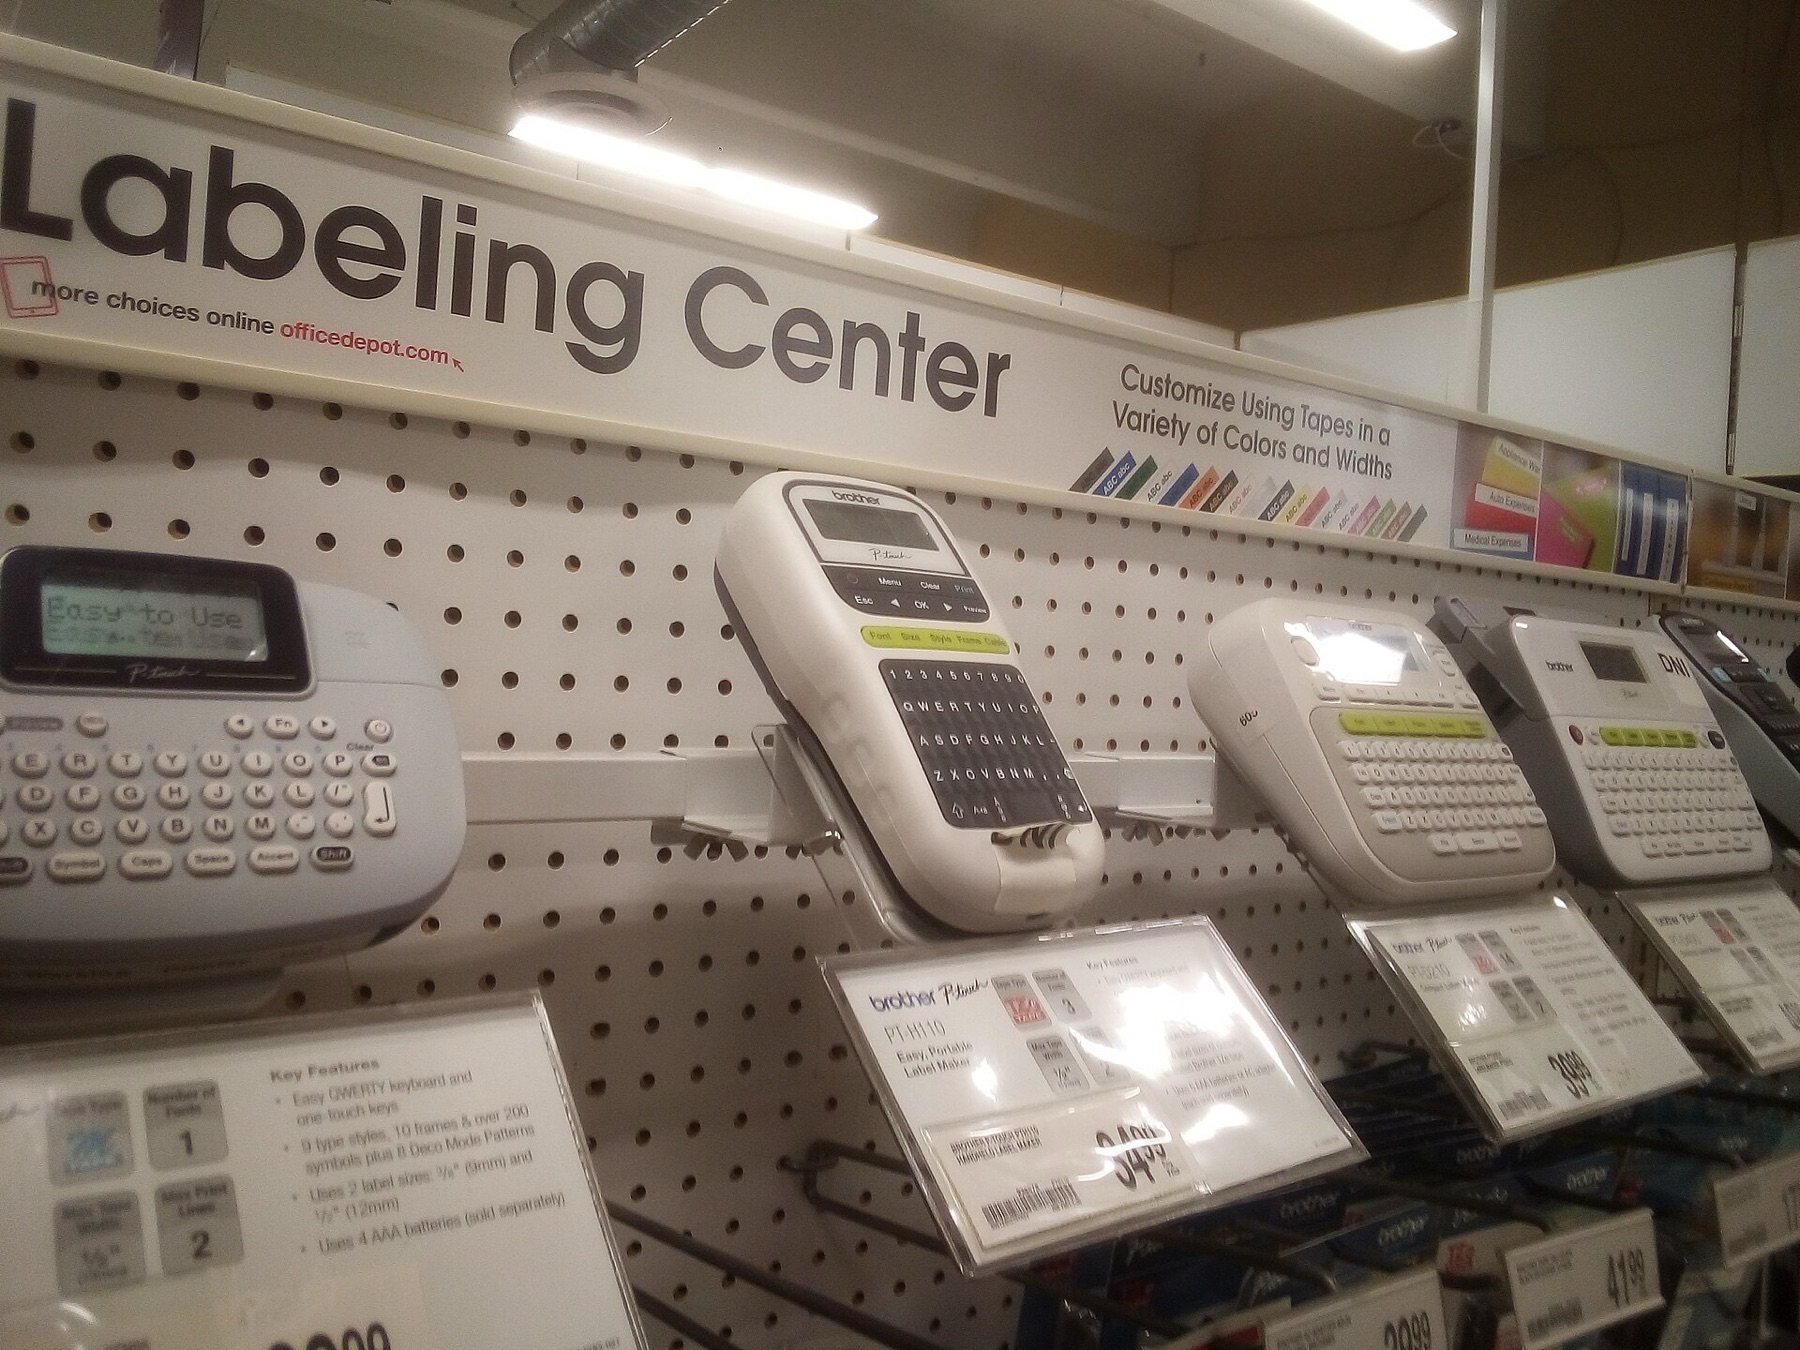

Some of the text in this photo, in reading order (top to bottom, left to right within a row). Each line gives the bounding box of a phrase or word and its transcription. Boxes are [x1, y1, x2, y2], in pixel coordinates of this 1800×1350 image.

[0, 97, 1011, 418] Labeling Center
[31, 280, 449, 366] more choices online officedepot.com
[1119, 363, 1391, 446] Customize Using Tapes in a
[1112, 400, 1393, 480] Variety of Colors and Widths
[1102, 462, 1130, 495] ABC abc
[1147, 470, 1173, 502] ABC abc
[832, 490, 880, 505] brother
[1489, 491, 1535, 513] Auto Expenses
[1464, 533, 1522, 548] Medical Expenses
[878, 576, 975, 595] Menu Clear Print
[48, 595, 243, 630] Easy to Use
[854, 595, 874, 606] Esc
[914, 600, 930, 611] OK
[869, 631, 891, 640] Font
[868, 989, 936, 1013] brother
[938, 977, 989, 1006] P-touch
[884, 1019, 946, 1044] PT-H110
[896, 1041, 973, 1064] Easy, Portable
[270, 1059, 380, 1083] Key Features
[904, 1057, 970, 1079] Label Maker
[388, 1072, 446, 1095] keyboard
[449, 1069, 473, 1086] and
[395, 1122, 412, 1140] 10
[503, 1102, 530, 1121] 200
[180, 1130, 193, 1155] 1
[483, 1124, 535, 1144] Patterns
[309, 1185, 345, 1202] Uses
[361, 1172, 395, 1194] label
[464, 1155, 507, 1177] (9mm)
[509, 1149, 533, 1167] and
[345, 1196, 400, 1221] (12mm)
[190, 1230, 211, 1261] 2
[318, 1236, 355, 1253] Uses
[371, 1222, 402, 1245] AAA
